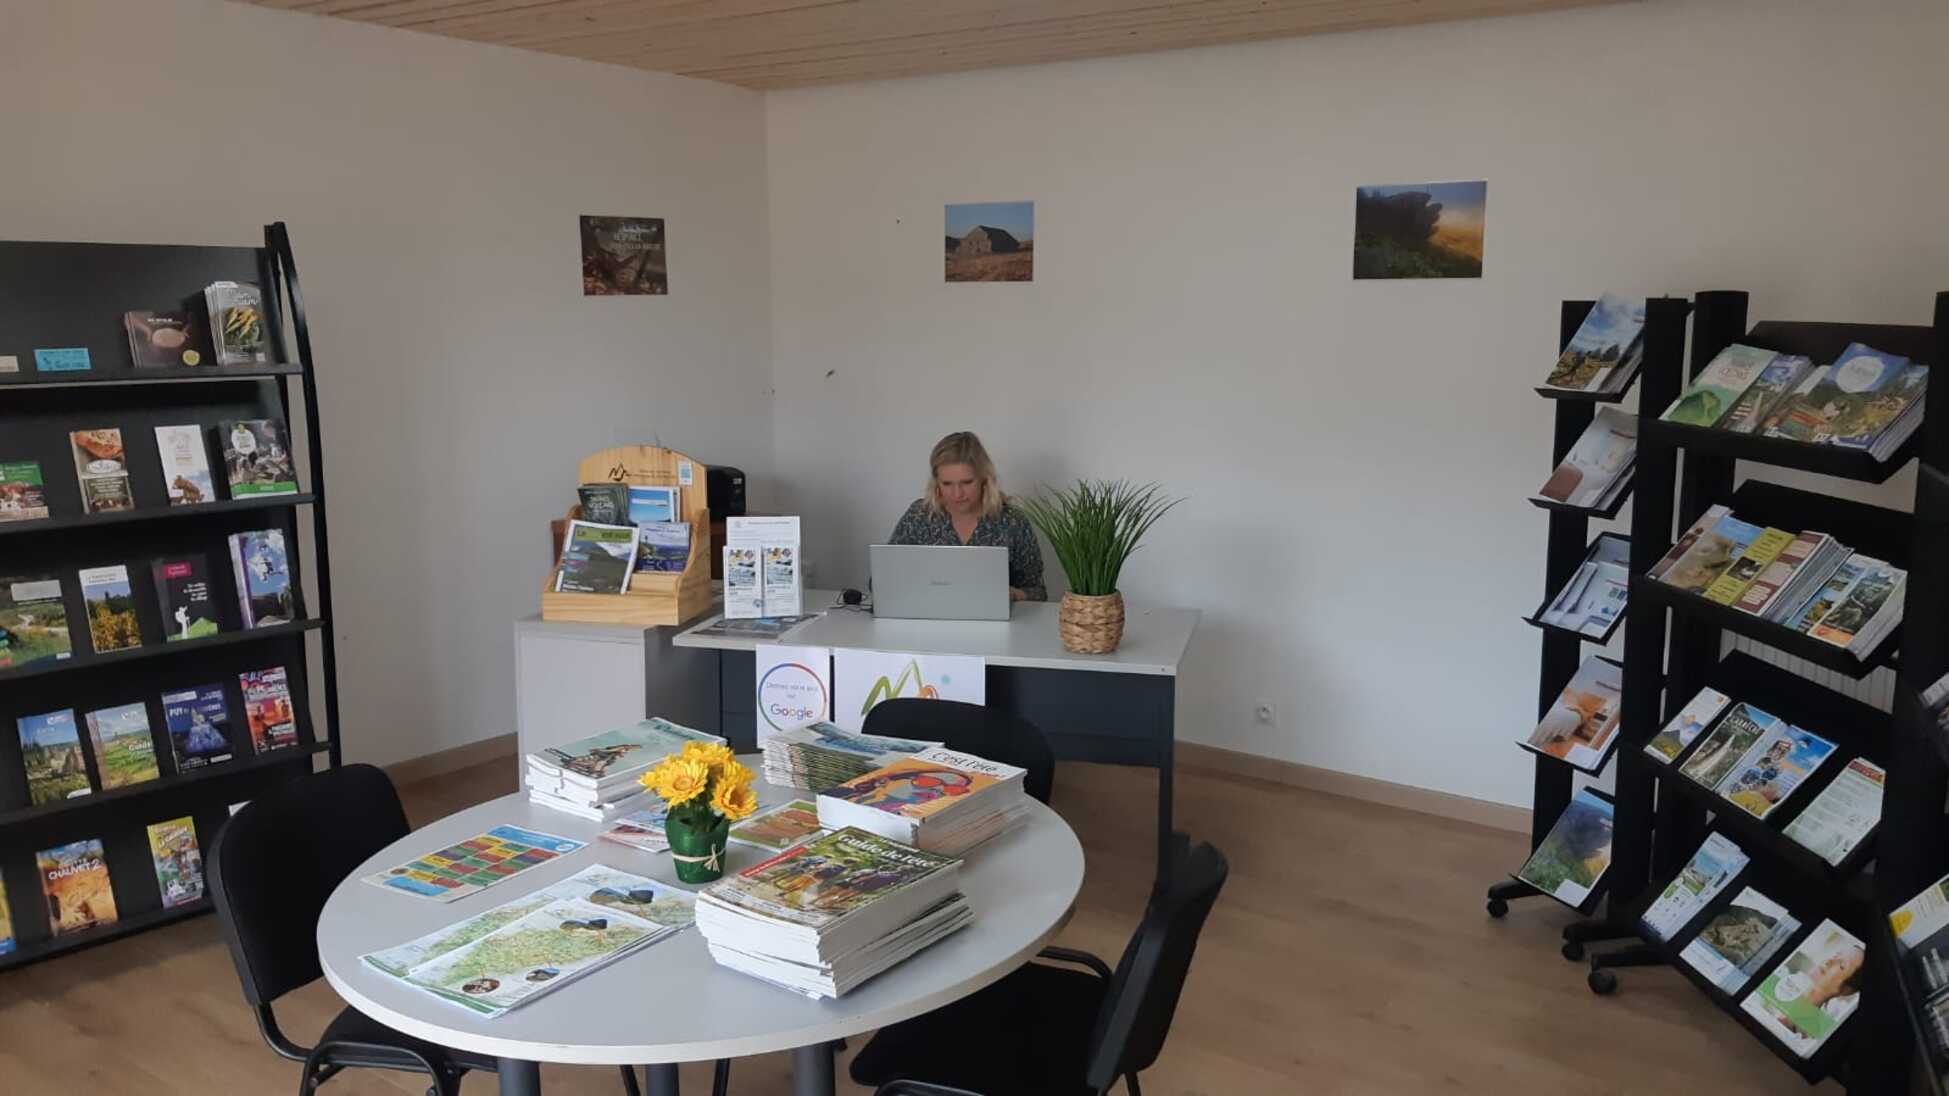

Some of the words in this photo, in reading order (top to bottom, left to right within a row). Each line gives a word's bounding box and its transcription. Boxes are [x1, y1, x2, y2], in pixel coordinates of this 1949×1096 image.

[771, 703, 813, 720] Google
[838, 834, 882, 853] Guide
[881, 849, 902, 860] de
